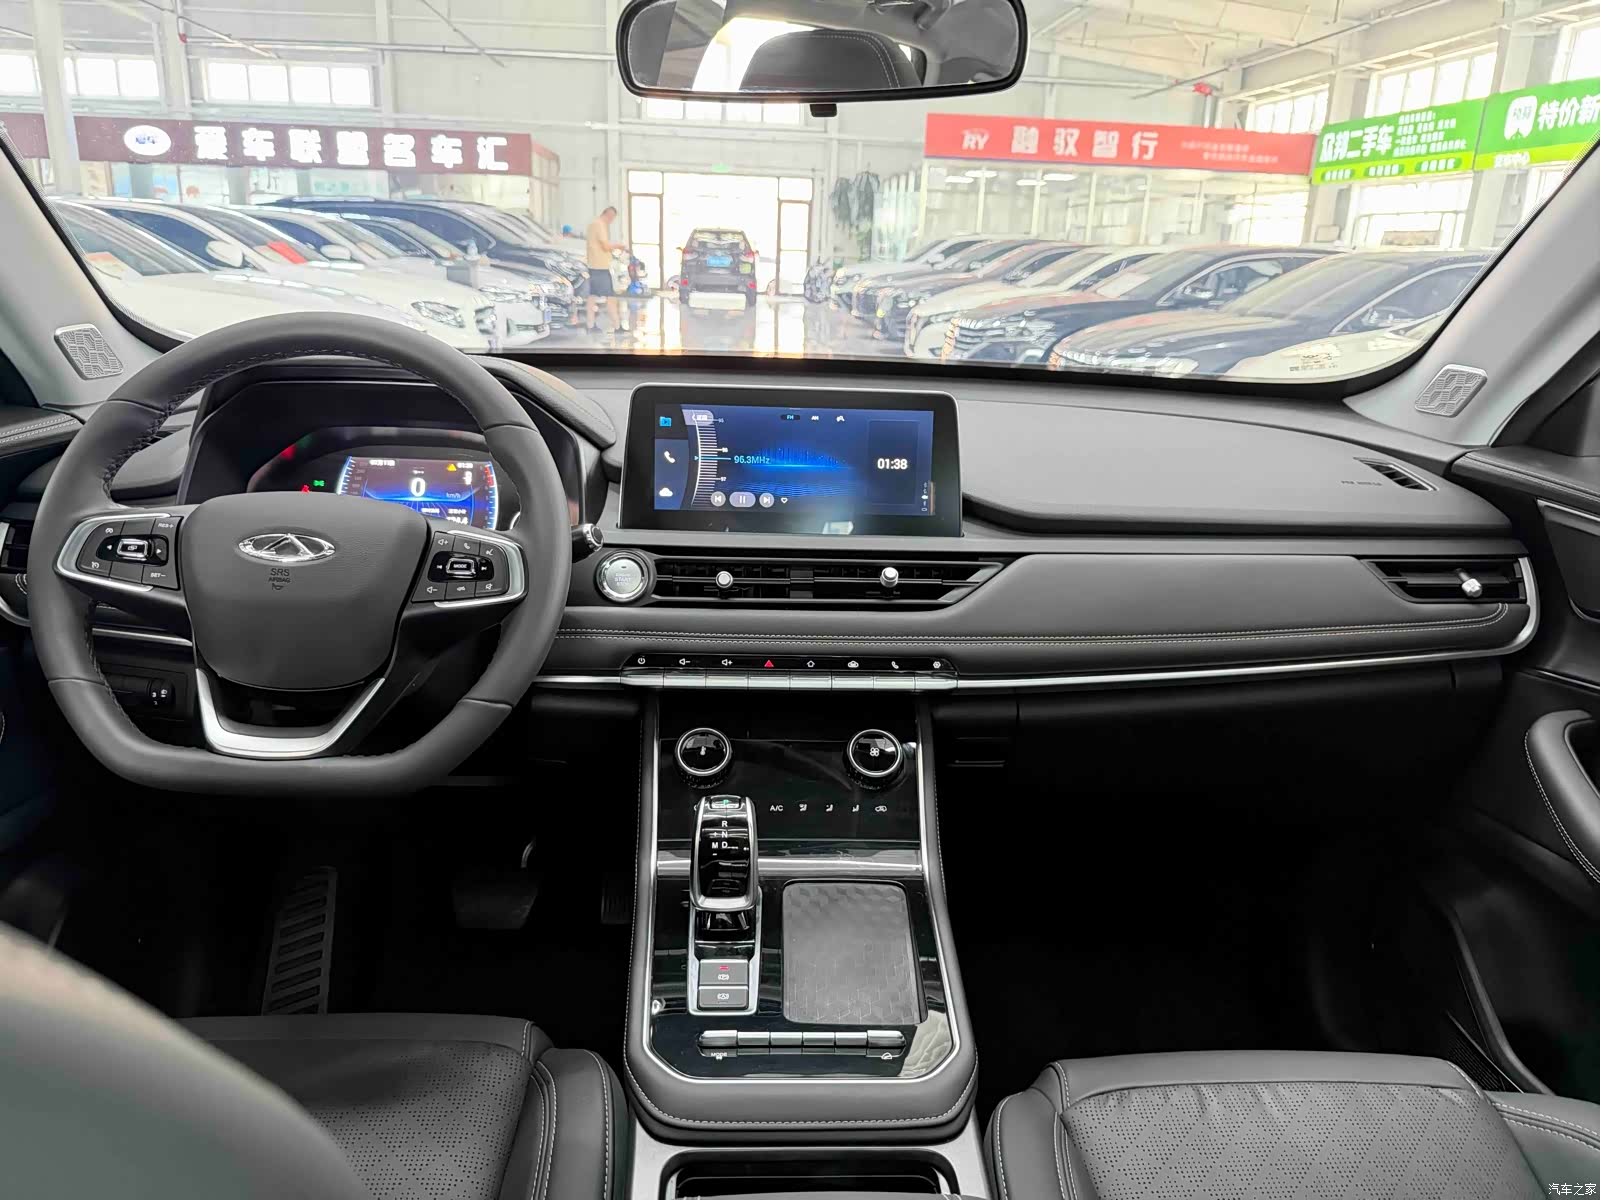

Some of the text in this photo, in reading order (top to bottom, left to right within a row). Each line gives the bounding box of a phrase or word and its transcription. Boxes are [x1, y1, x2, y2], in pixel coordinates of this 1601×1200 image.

[193, 125, 509, 171] 爱车联盟名车汇
[733, 455, 771, 465] 96.3MHz
[877, 457, 908, 470] 01:38
[410, 477, 426, 497] 0
[270, 567, 290, 577] SRS
[769, 804, 784, 812] A/C
[721, 820, 728, 828] R
[711, 841, 719, 849] M
[721, 841, 728, 849] D
